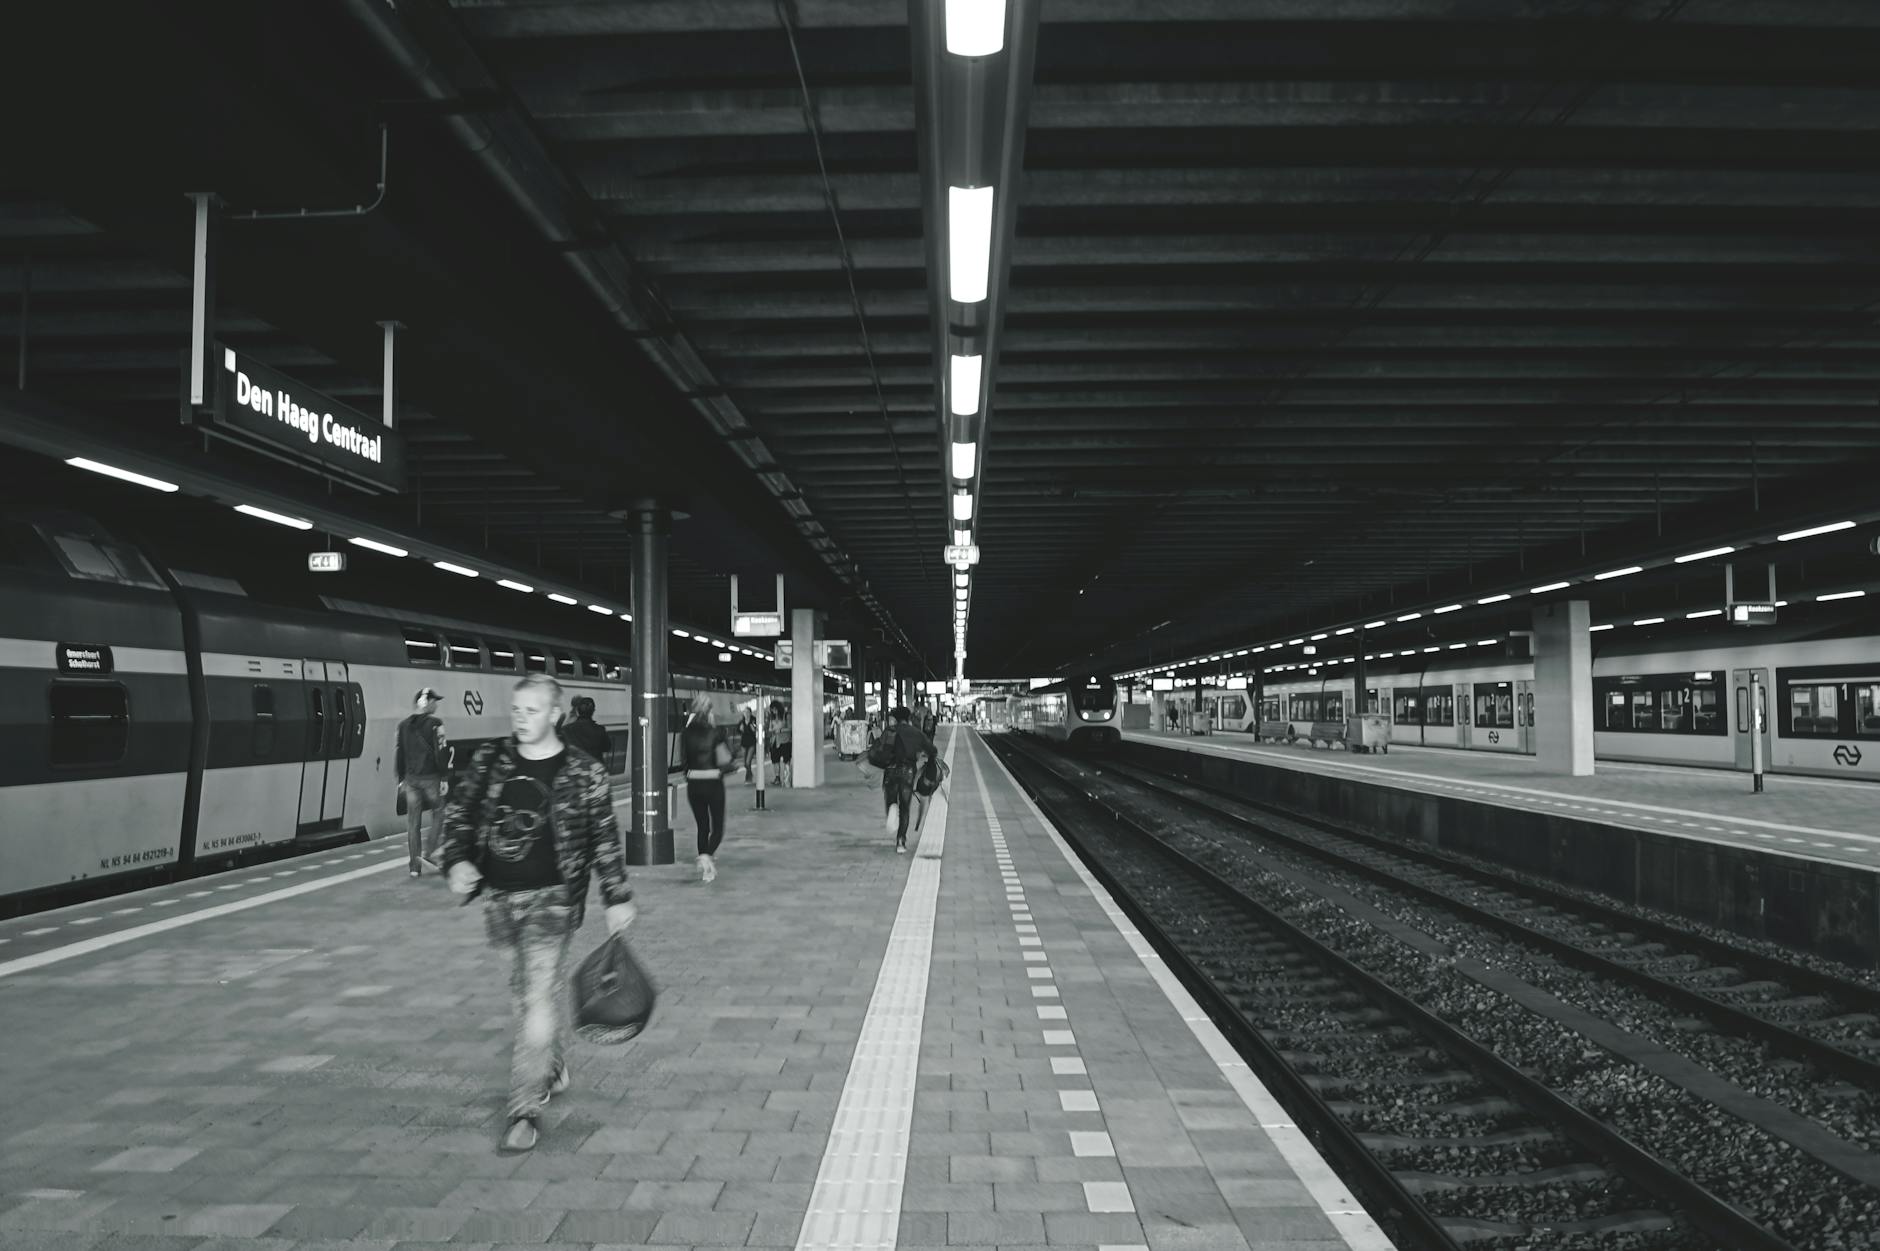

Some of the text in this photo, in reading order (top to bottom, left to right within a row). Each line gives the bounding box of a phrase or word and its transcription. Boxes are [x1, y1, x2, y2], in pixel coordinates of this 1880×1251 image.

[237, 371, 381, 463] Den Haag Centraal
[443, 645, 451, 668] 2
[1490, 693, 1495, 705] 2
[1684, 688, 1690, 703] 2
[1841, 683, 1848, 701] 1
[447, 746, 455, 769] 2
[101, 858, 110, 869] NL
[112, 856, 121, 866] NS
